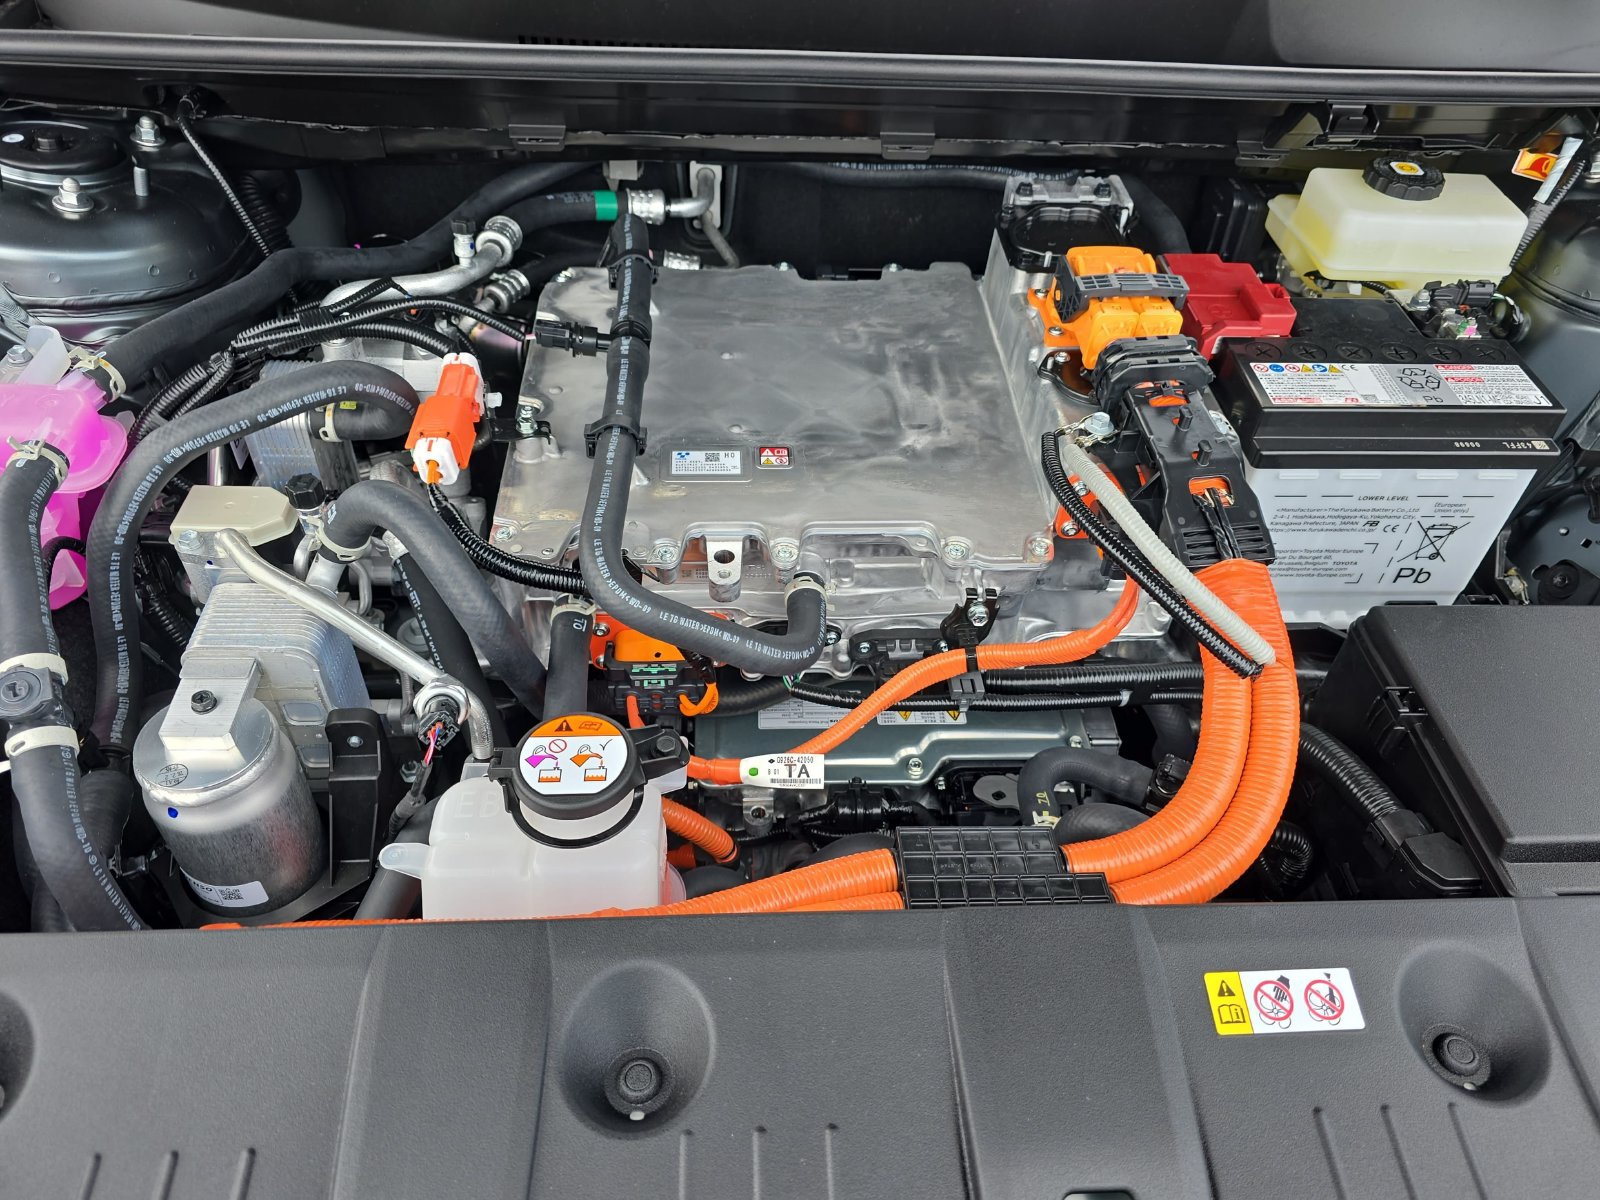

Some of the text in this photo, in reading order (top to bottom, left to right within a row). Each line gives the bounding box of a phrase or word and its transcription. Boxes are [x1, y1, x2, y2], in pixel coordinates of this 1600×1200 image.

[596, 555, 610, 579] WATER
[1393, 567, 1432, 585] Pb
[659, 611, 669, 620] LE
[680, 616, 700, 631] WATER
[746, 640, 753, 649] LE
[762, 645, 781, 658] WATER
[784, 764, 810, 778] TA
